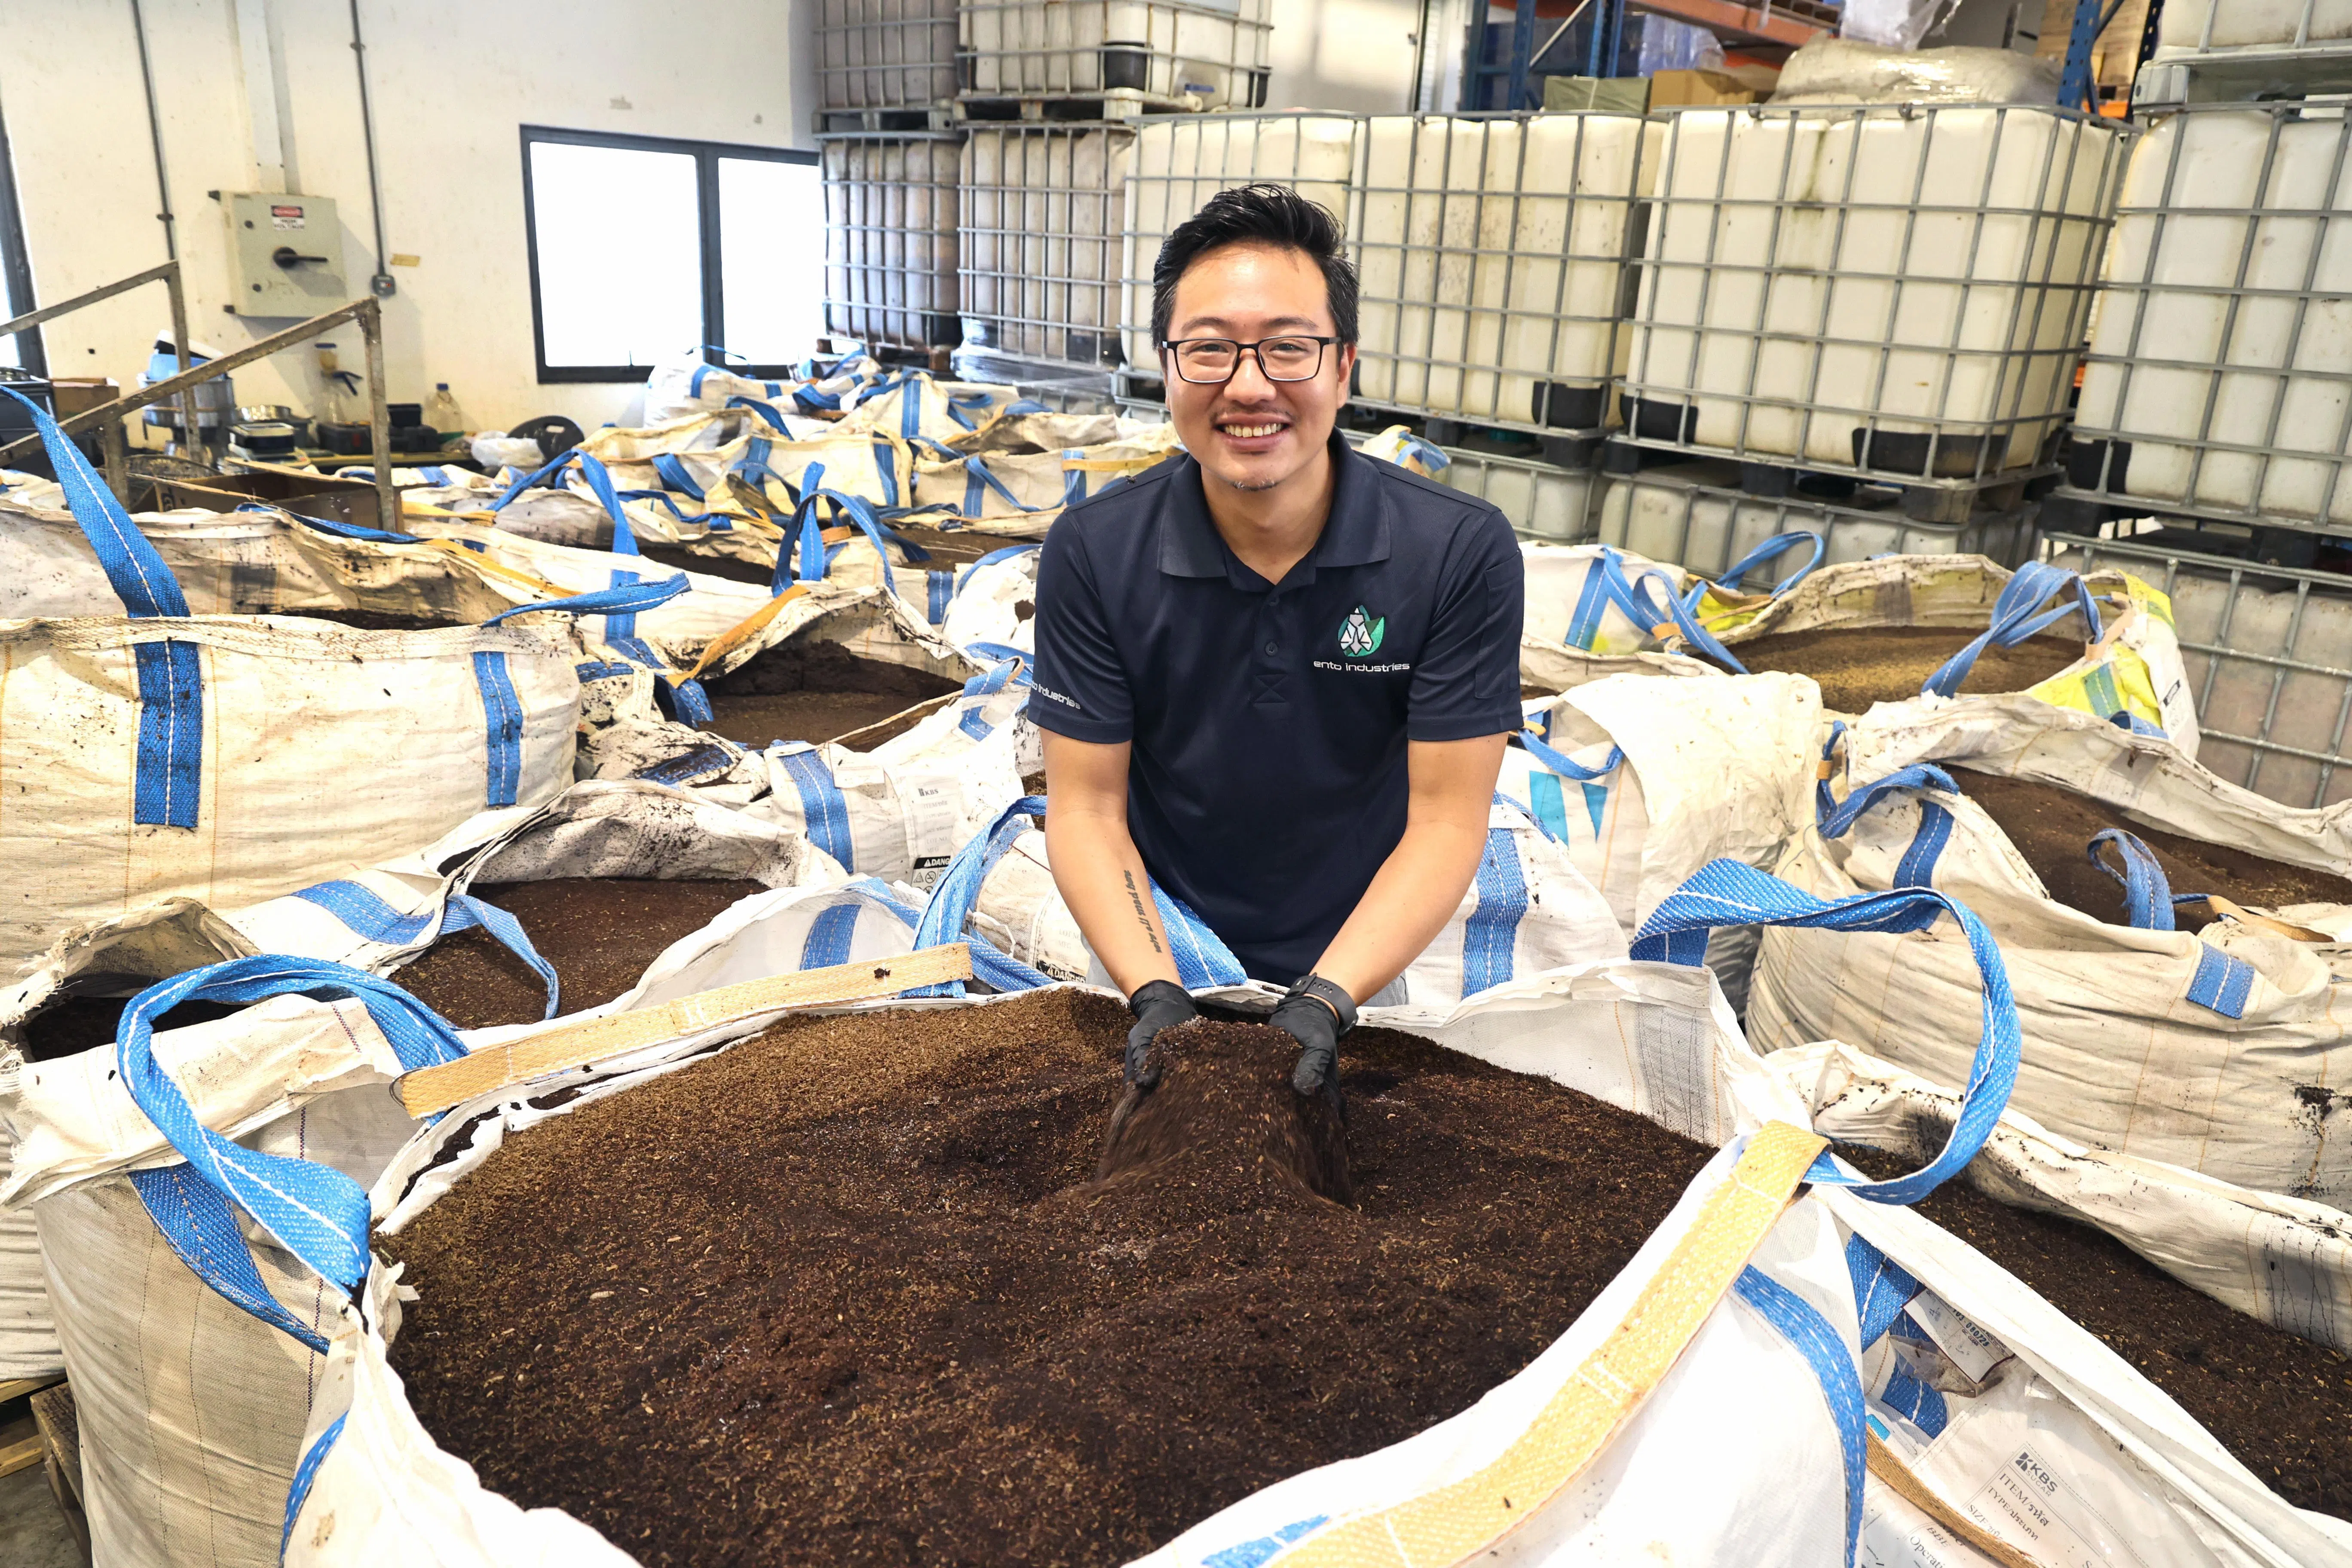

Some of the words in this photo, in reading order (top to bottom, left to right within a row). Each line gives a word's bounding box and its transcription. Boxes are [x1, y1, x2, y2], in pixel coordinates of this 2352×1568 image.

[1314, 661, 1341, 671] ento
[1345, 663, 1410, 672] industries
[1038, 683, 1081, 710] industries
[2026, 1470, 2052, 1497] SUGAR
[2030, 1463, 2058, 1492] KBS
[1926, 1527, 1951, 1547] BBE
